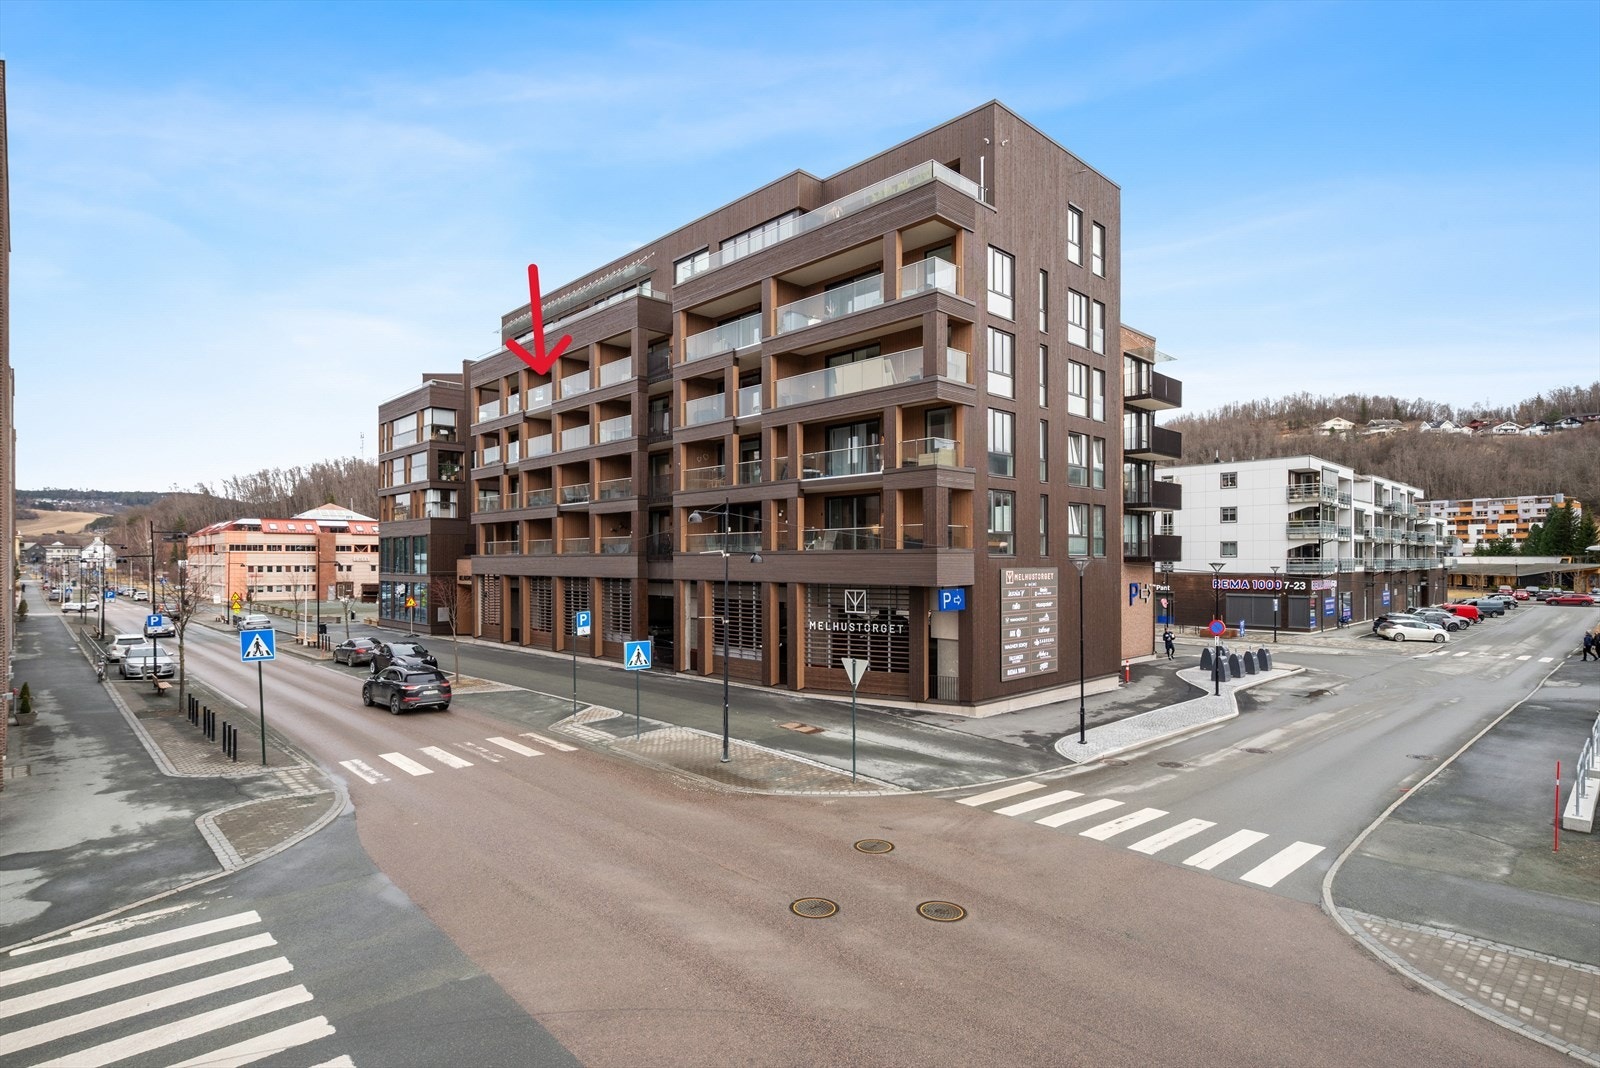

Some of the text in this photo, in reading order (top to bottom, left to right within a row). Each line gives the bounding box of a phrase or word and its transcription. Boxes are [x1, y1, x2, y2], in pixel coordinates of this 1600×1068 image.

[1212, 579, 1250, 590] REMA
[1252, 579, 1282, 590] 1000
[1283, 581, 1306, 590] 7-23
[943, 592, 951, 609] P
[150, 616, 159, 626] P
[580, 614, 587, 626] P
[809, 621, 904, 634] MELHUSTORGET
